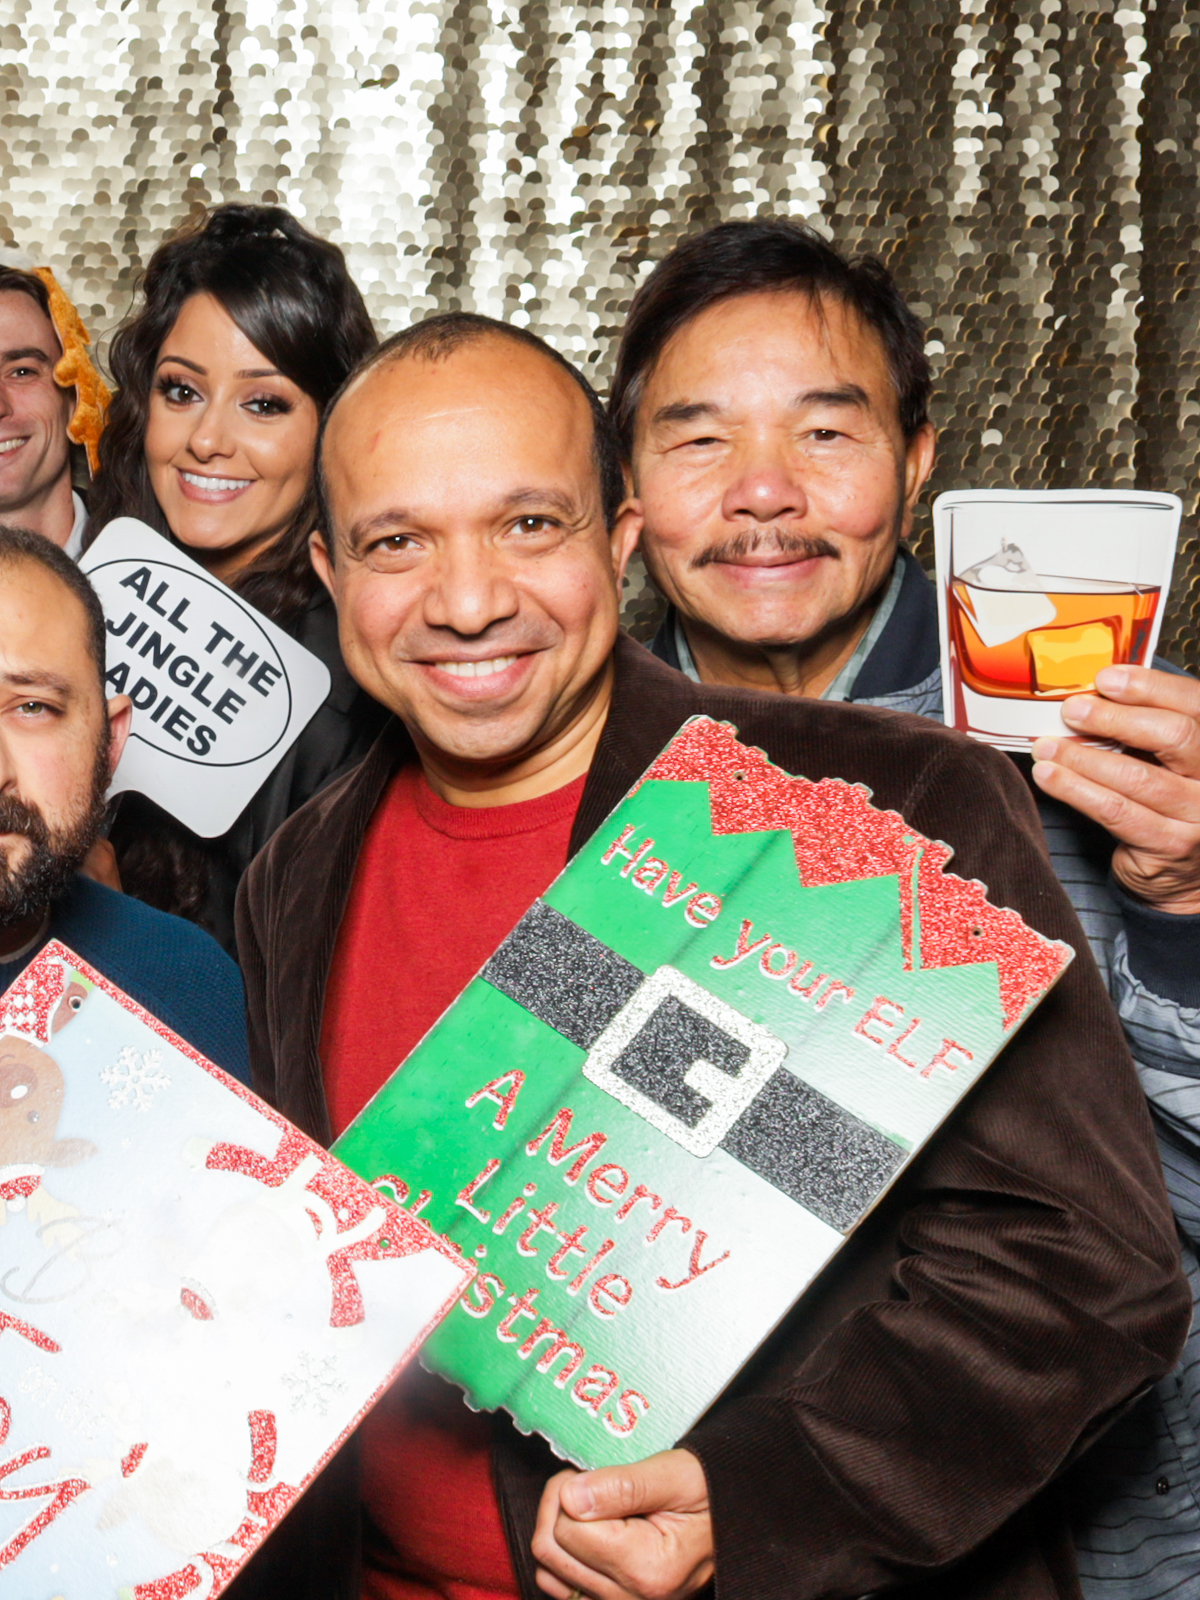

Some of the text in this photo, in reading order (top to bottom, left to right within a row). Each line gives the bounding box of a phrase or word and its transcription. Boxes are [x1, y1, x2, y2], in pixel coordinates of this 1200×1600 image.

[106, 612, 247, 725] JINGLE
[119, 566, 283, 697] ALL THE
[105, 661, 217, 756] ADIES
[600, 823, 974, 1082] Have your ELF
[455, 1158, 633, 1320] Little
[465, 1069, 731, 1290] A Merry
